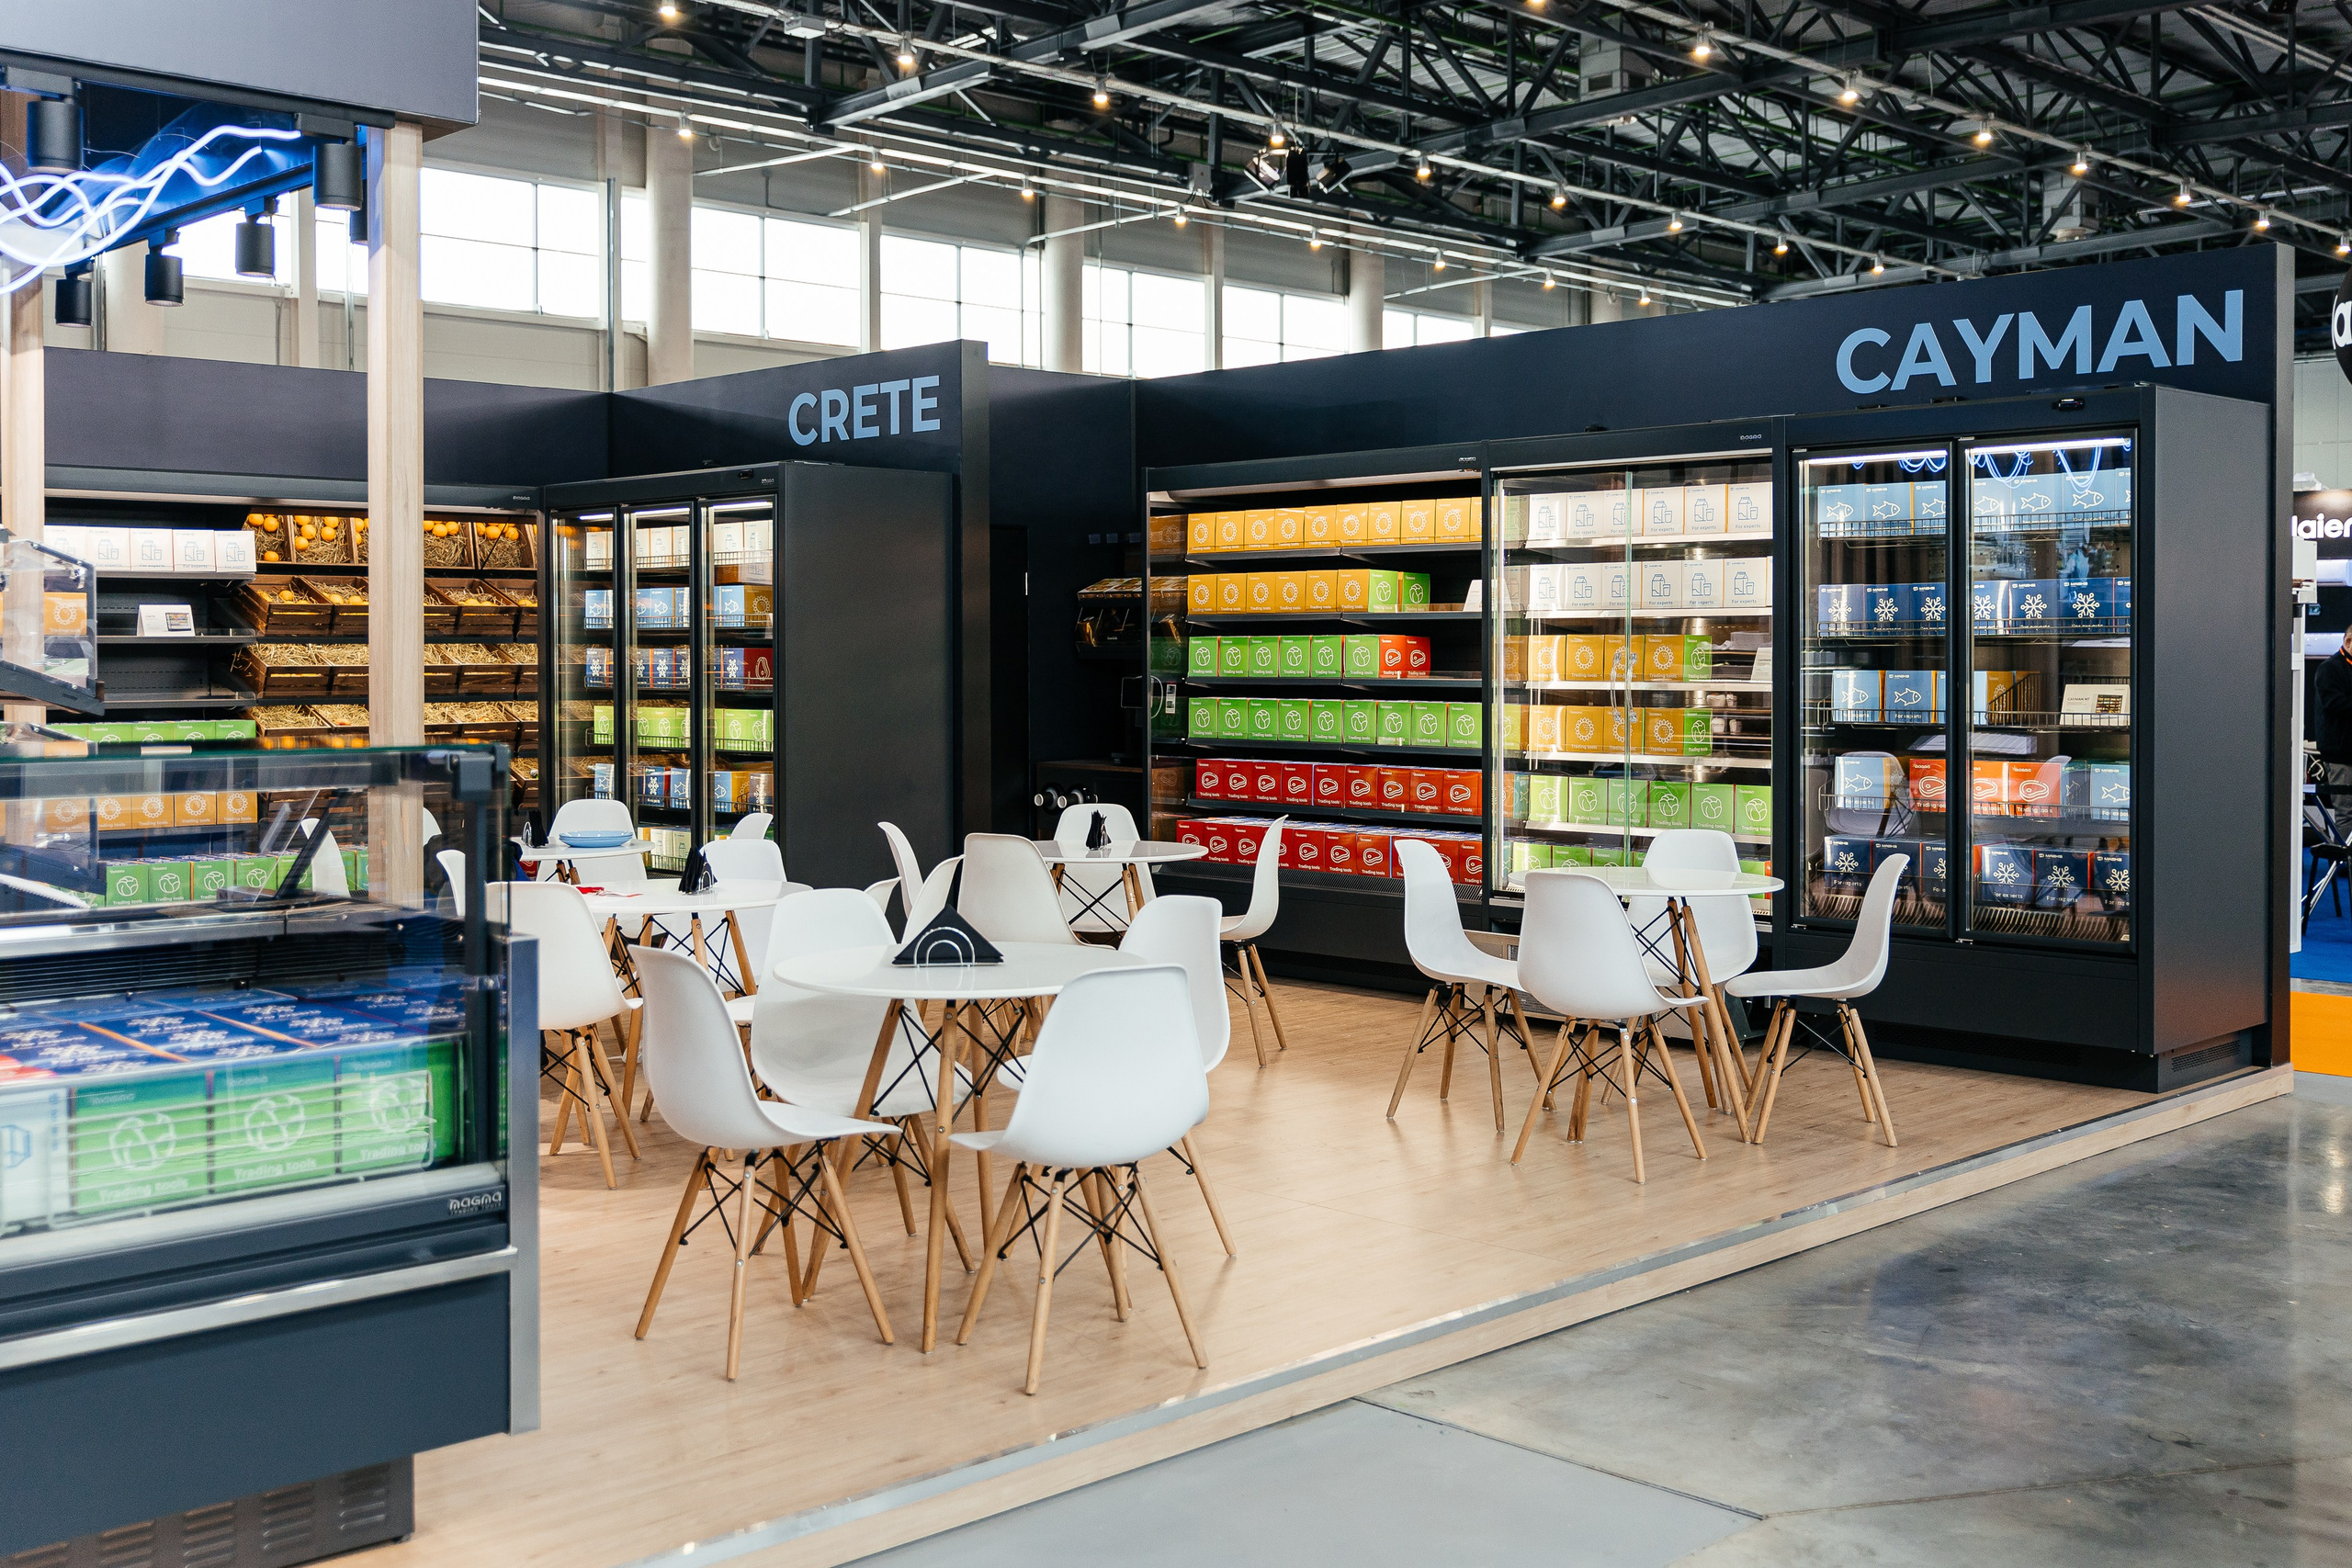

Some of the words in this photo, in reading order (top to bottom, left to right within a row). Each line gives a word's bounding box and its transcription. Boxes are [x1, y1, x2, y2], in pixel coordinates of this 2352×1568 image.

[1836, 289, 2244, 395] CAYMAN
[788, 375, 941, 446] CRETE
[234, 1164, 283, 1182] Trading
[287, 1158, 317, 1173] tools
[360, 1145, 405, 1161] Trading
